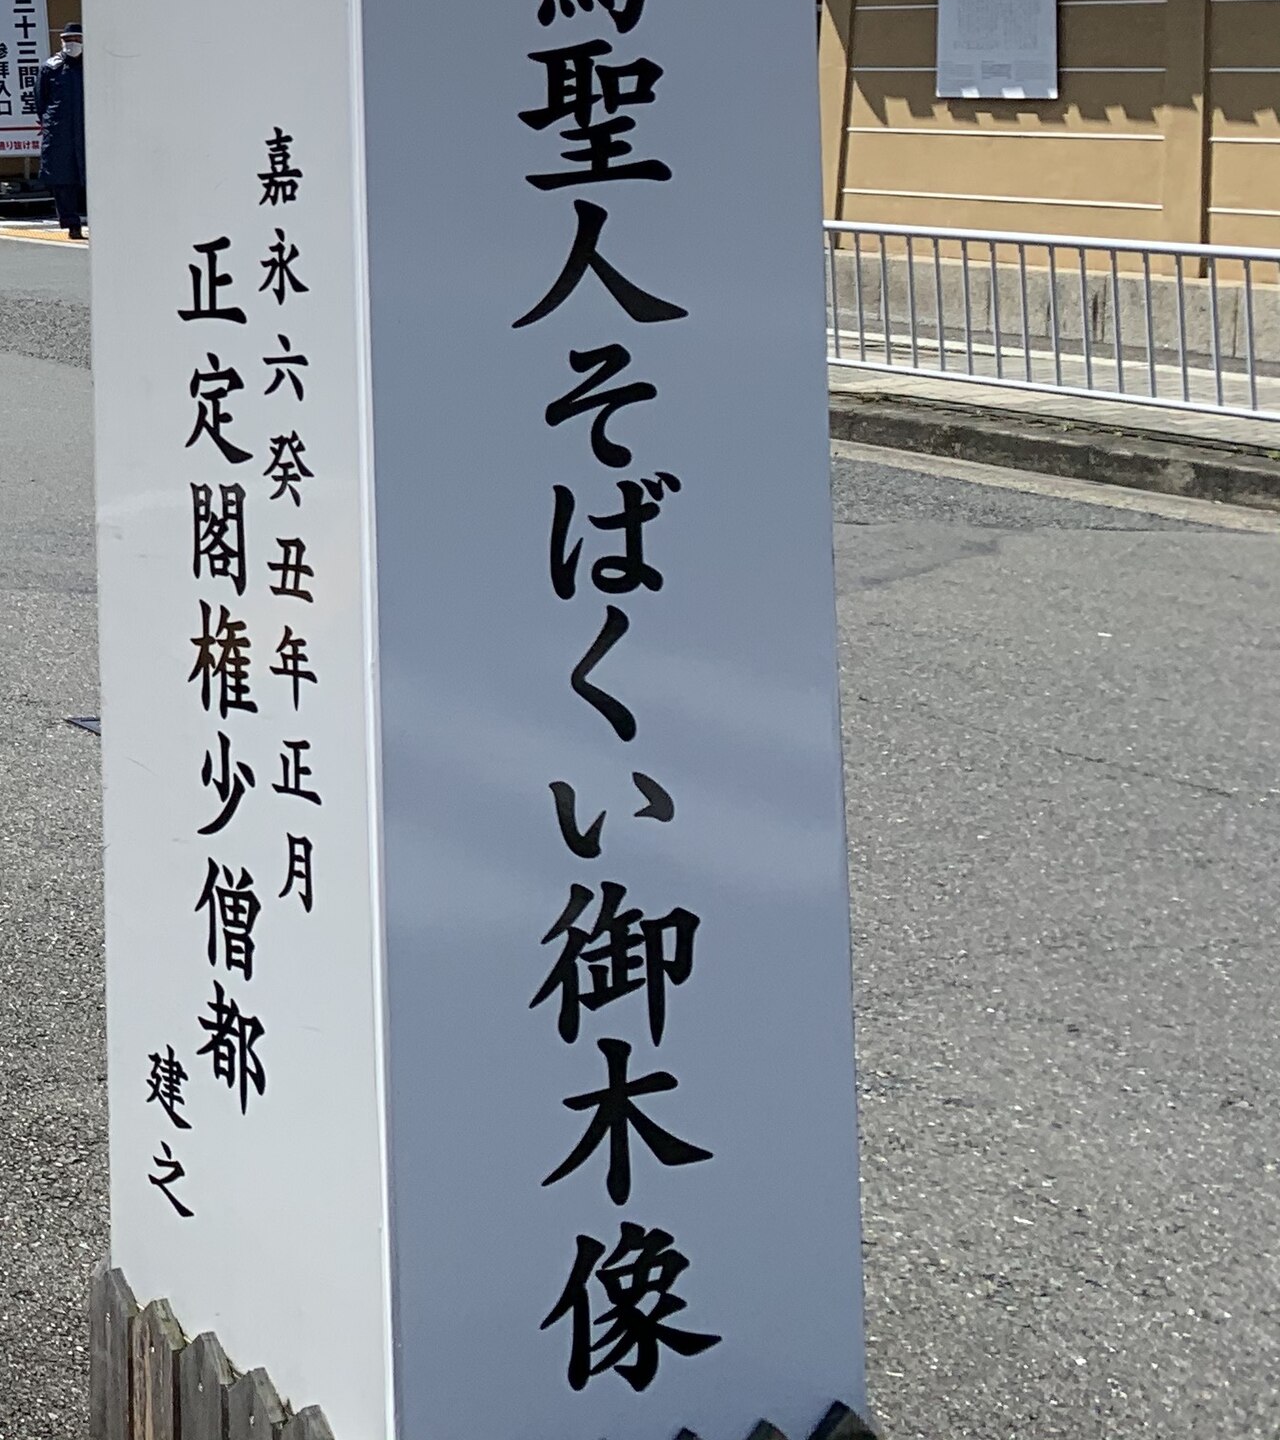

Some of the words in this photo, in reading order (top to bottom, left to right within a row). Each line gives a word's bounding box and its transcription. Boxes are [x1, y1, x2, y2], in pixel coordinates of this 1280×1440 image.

[177, 236, 266, 1115] 正定閣権少僧都
[257, 126, 321, 913] 嘉永六癸丑年正月
[146, 1044, 195, 1218] 建之
